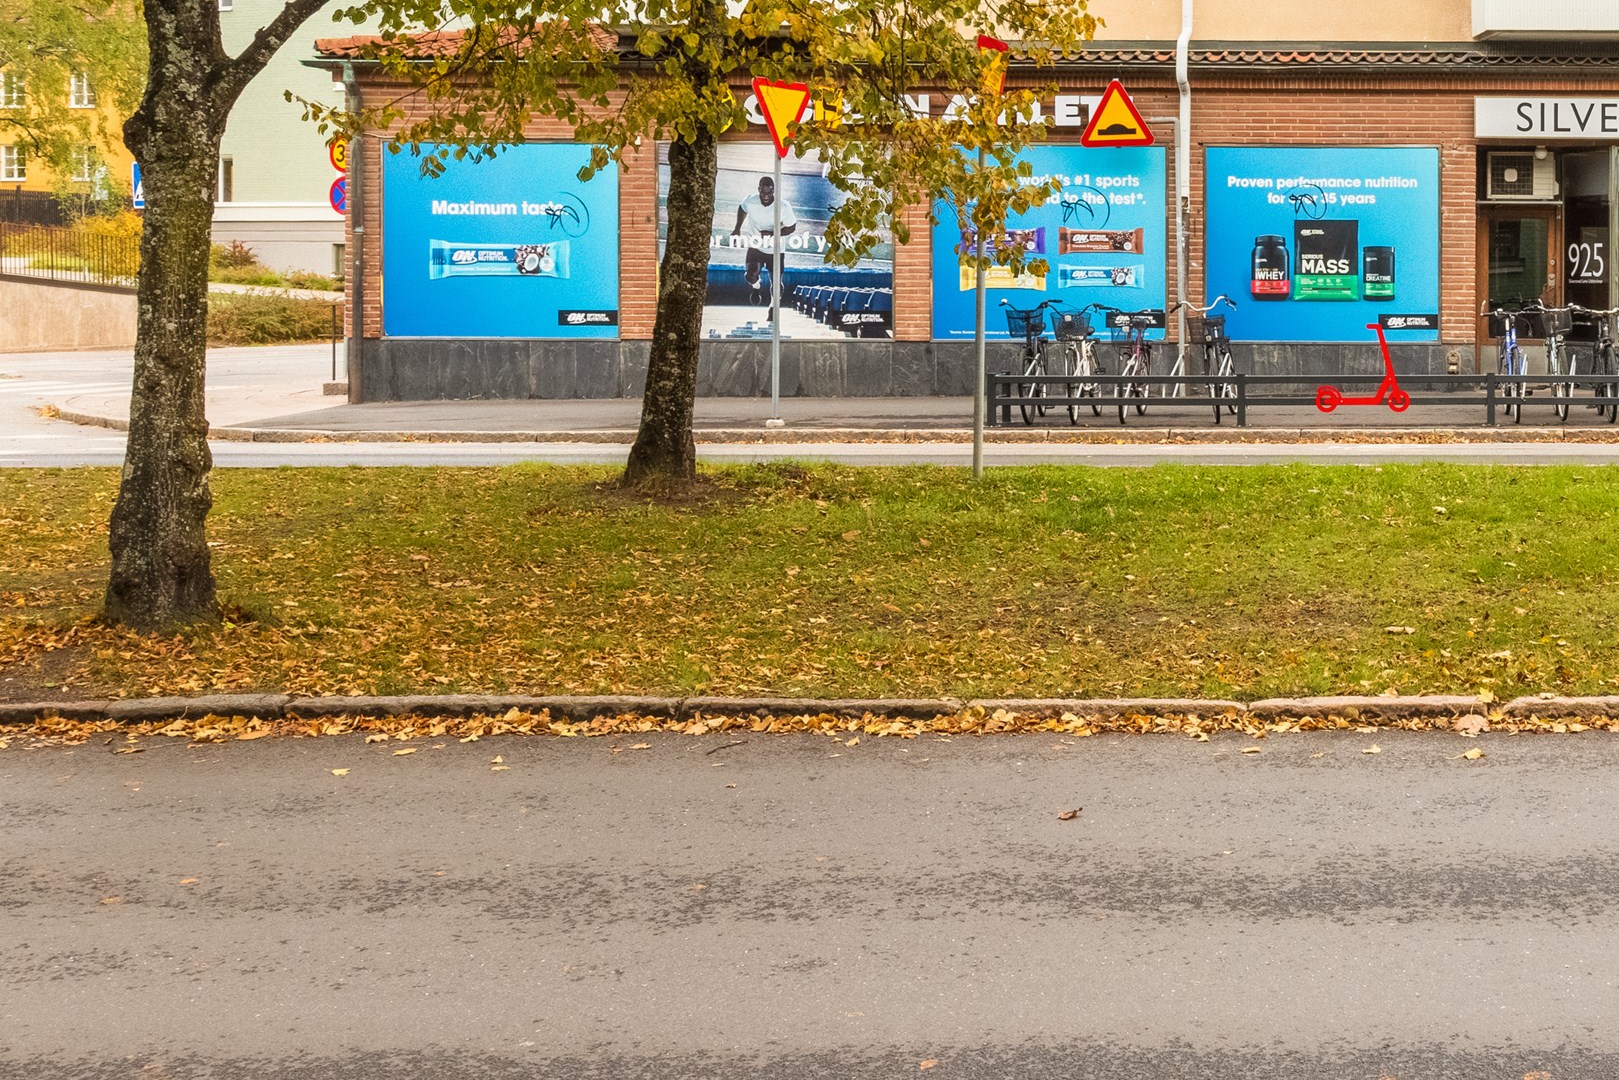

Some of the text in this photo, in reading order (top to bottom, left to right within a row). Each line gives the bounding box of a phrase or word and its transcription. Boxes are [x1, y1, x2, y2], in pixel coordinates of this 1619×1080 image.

[1074, 174, 1090, 186] #1
[1095, 175, 1140, 189] sports
[1227, 176, 1418, 190] Proven performance nutrition
[1063, 192, 1079, 203] to
[1082, 192, 1105, 204] the
[1267, 192, 1285, 204] for
[1320, 193, 1337, 204] 35
[1340, 195, 1376, 206] years
[431, 200, 517, 215] Maximum
[788, 231, 810, 249] of
[1302, 259, 1349, 273] MASS
[1568, 243, 1604, 277] 925
